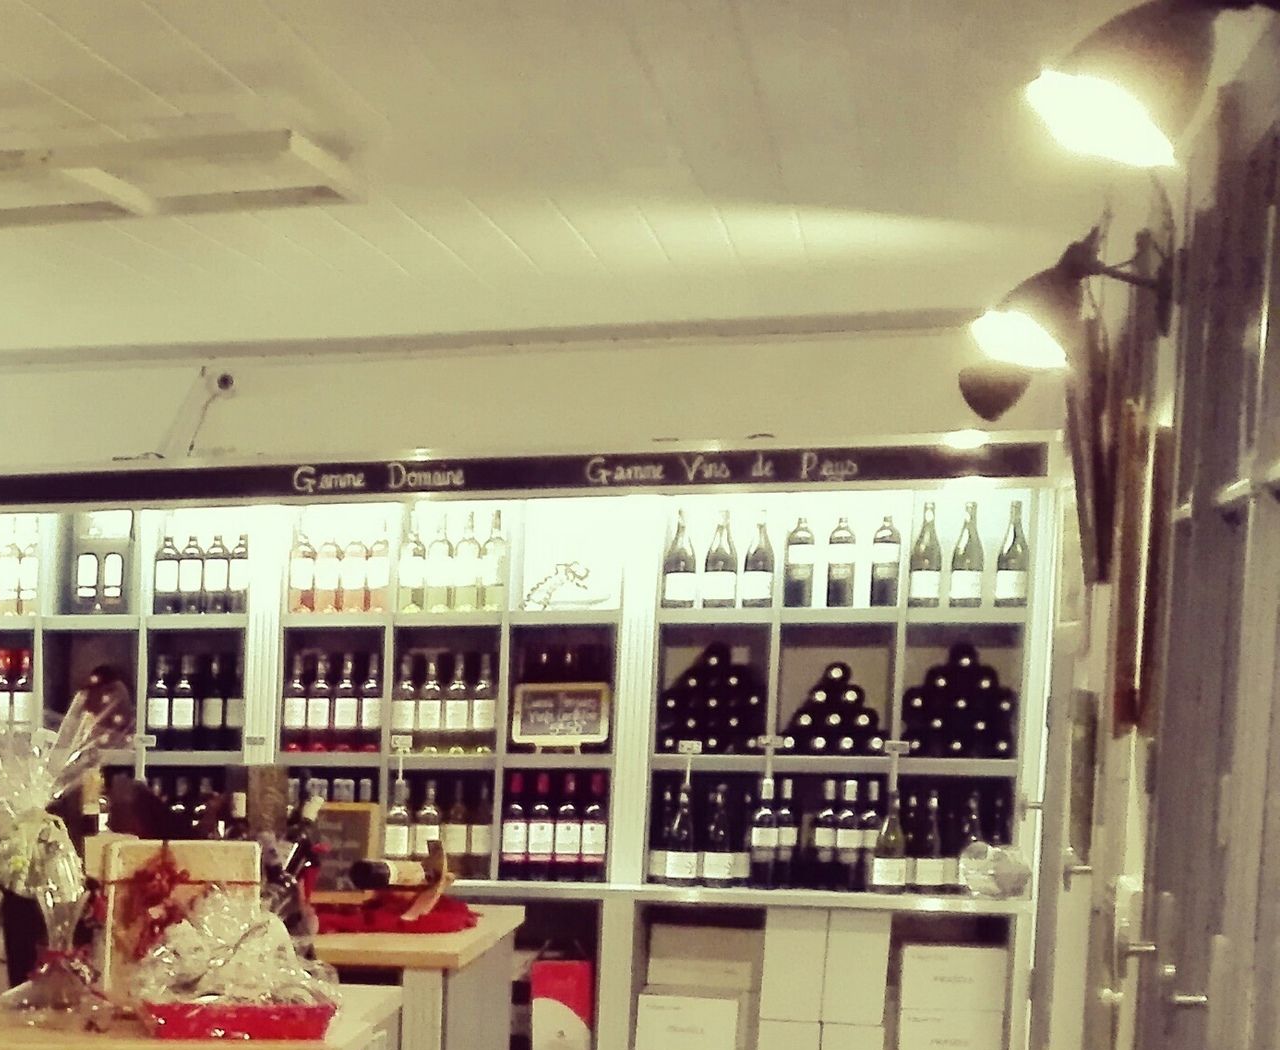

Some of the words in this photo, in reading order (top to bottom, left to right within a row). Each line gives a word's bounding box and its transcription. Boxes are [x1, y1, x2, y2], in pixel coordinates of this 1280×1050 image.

[293, 465, 366, 493] Gamme
[388, 461, 464, 489] Domaine
[586, 456, 664, 484] Gamme
[752, 453, 773, 477] de
